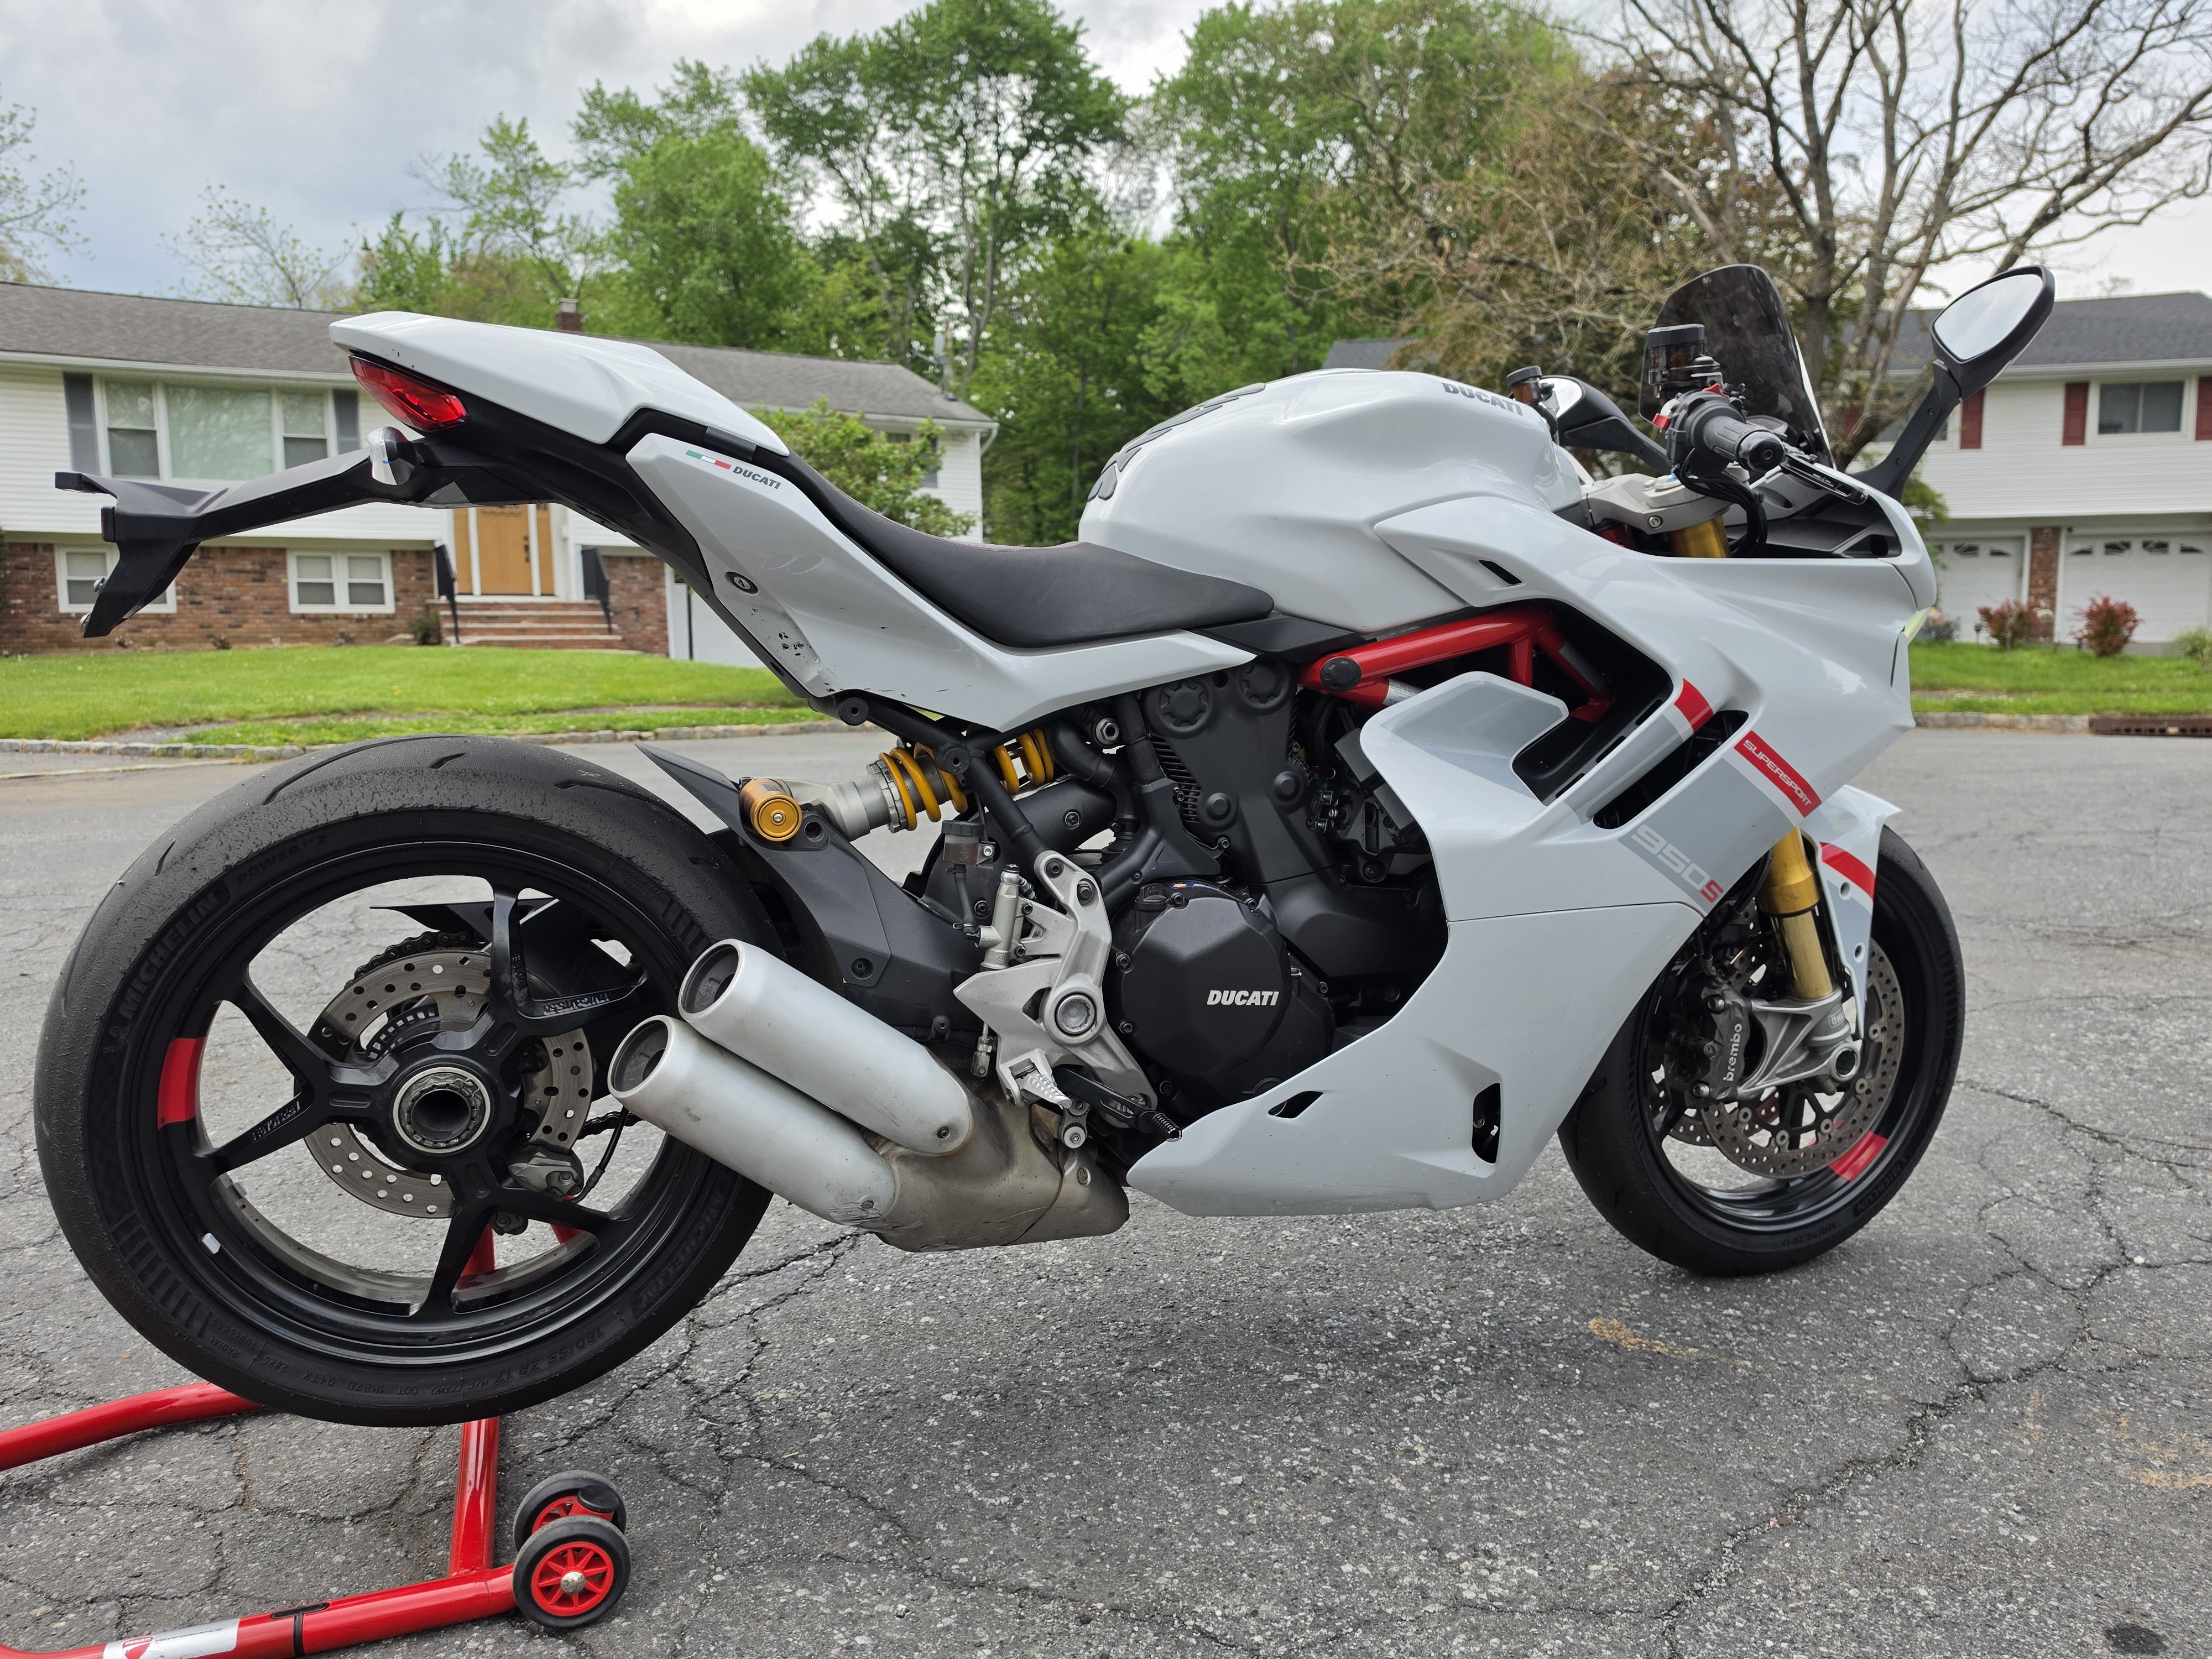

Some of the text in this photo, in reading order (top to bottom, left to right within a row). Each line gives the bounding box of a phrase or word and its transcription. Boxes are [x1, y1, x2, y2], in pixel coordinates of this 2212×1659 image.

[1442, 382, 1524, 416] DUCATI
[732, 466, 781, 489] DUCATI
[1743, 739, 1812, 806] SUPERSPORT
[236, 844, 301, 885] POWER
[317, 835, 328, 846] 2
[118, 891, 220, 1021] MICHELIN
[1206, 989, 1279, 1006] DUCATI
[1723, 1023, 1743, 1082] brembo
[1857, 1163, 1902, 1212] MICHELIN
[640, 1188, 727, 1307] MICHELIN
[209, 1334, 241, 1359] RADIAL
[549, 1329, 605, 1365] 180/55
[494, 1369, 514, 1384] 17
[519, 1360, 542, 1376] ZR
[397, 1385, 419, 1395] DOT
[467, 1378, 490, 1390] M/C
[125, 1627, 223, 1646] DUCATI PERFORMANCE
